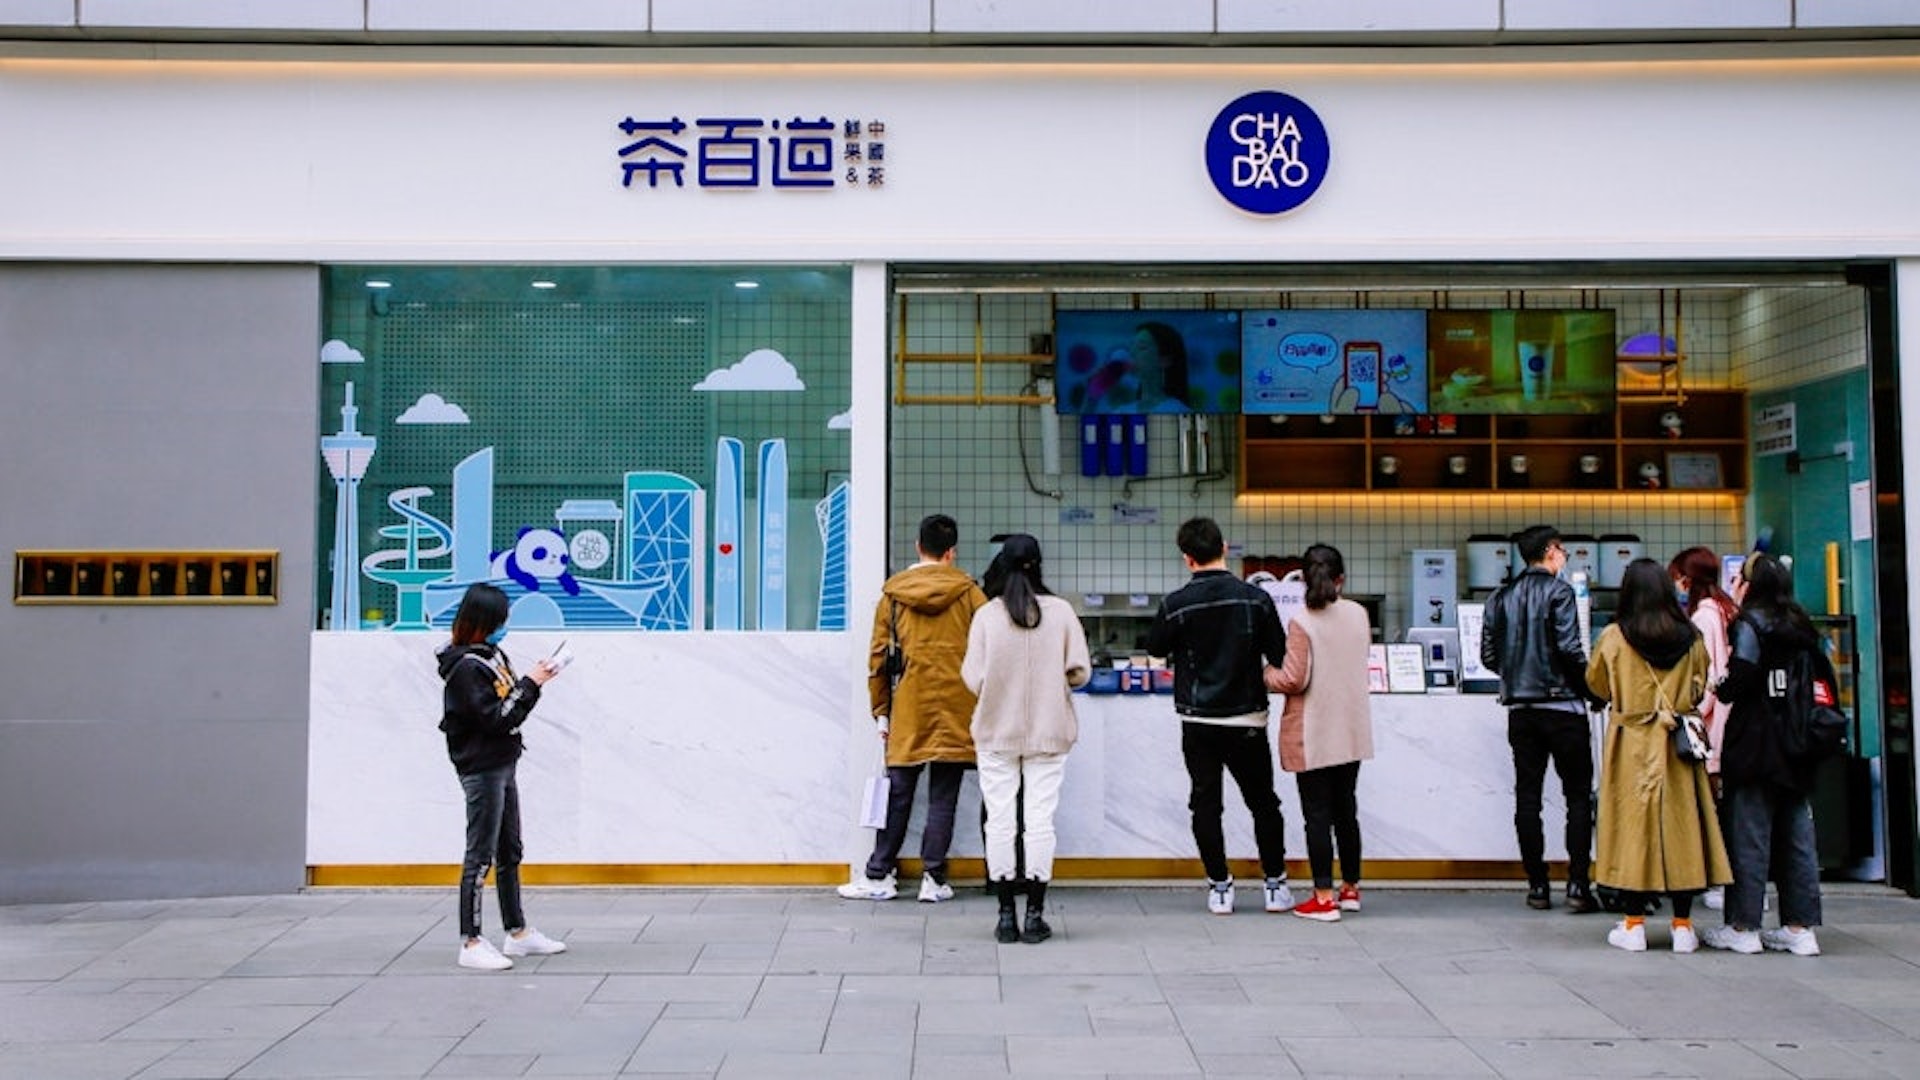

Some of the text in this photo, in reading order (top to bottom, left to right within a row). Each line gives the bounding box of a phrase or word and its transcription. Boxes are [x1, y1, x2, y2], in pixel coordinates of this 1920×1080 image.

[1230, 113, 1302, 145] CHA
[618, 116, 835, 187] 茶百道
[1249, 137, 1299, 165] BAI
[1232, 155, 1309, 189] DAO
